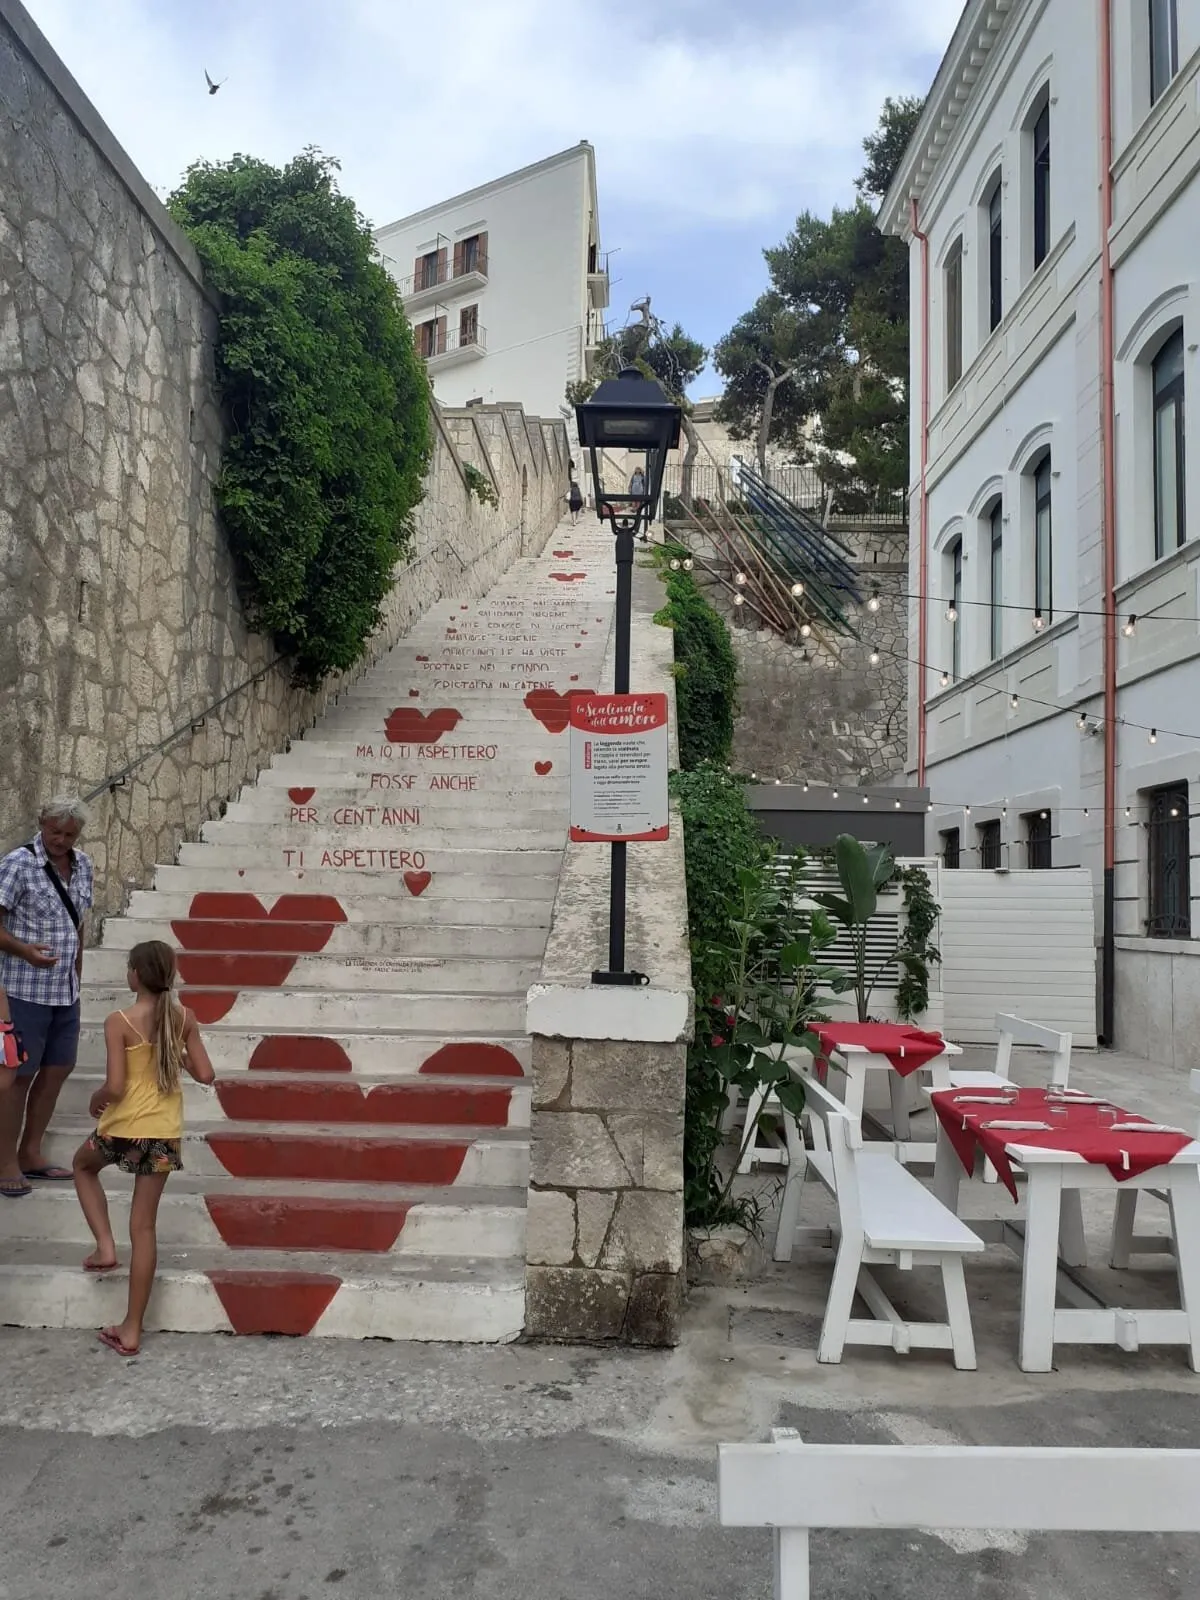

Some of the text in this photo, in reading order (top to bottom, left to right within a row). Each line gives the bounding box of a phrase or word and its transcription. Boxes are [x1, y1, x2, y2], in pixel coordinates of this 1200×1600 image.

[586, 701, 645, 717] Scalinata
[356, 746, 374, 758] MA
[380, 746, 392, 758] IO
[400, 746, 410, 758] TI
[371, 774, 479, 790] FOSSE ANCHE
[289, 808, 420, 826] PER CENT'ANNI
[283, 850, 304, 867] TI
